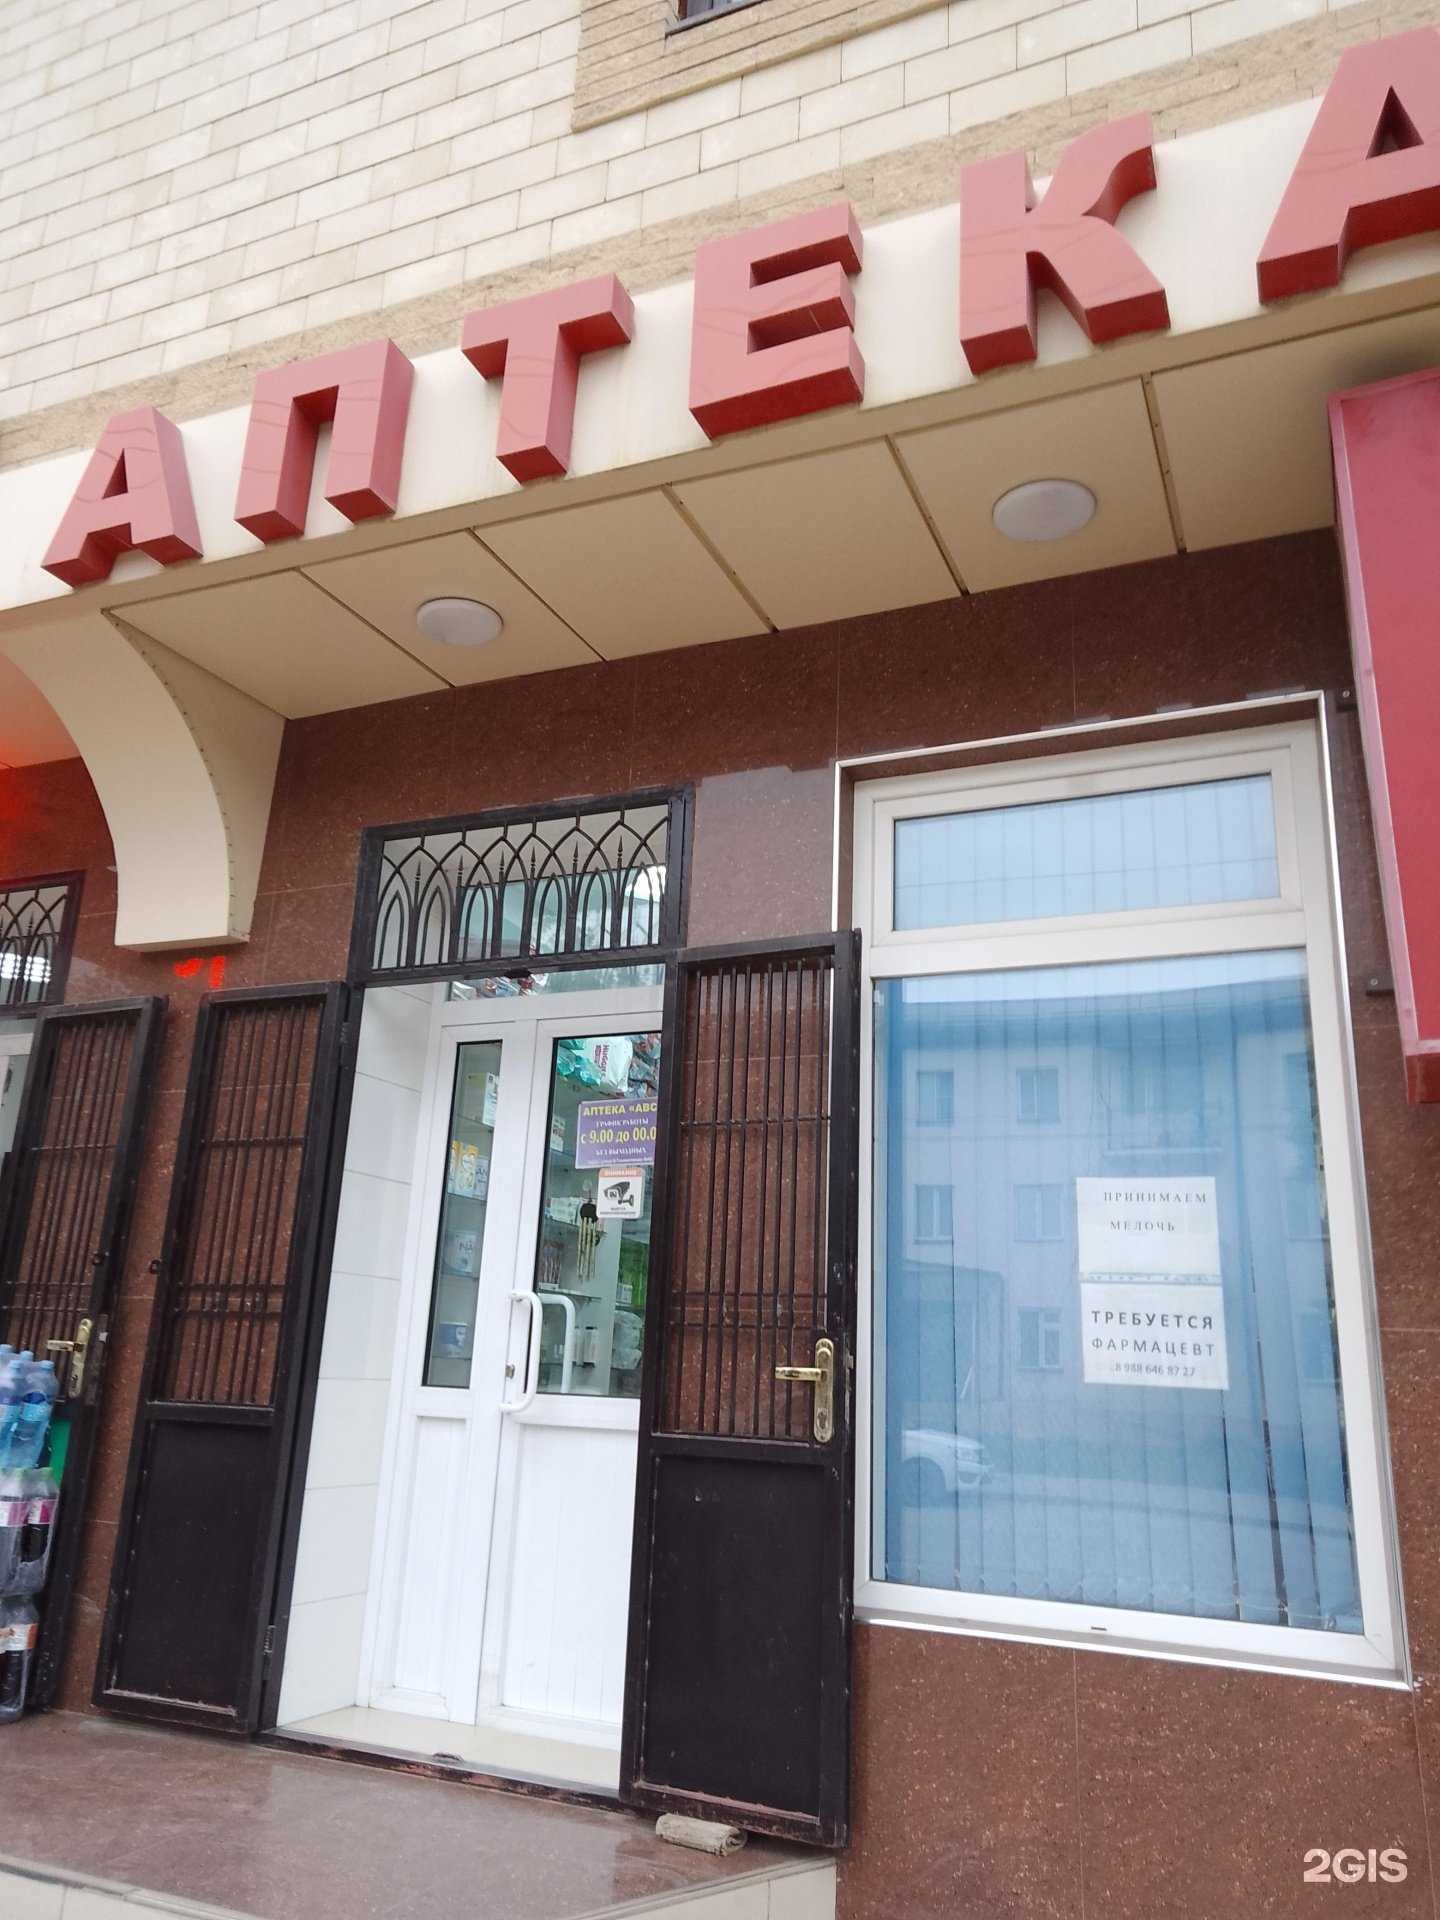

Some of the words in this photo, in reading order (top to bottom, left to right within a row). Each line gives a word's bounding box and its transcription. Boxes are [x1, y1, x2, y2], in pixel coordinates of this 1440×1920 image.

[41, 26, 1440, 588] АПТЕКА
[584, 1105, 626, 1116] АПТЕКА
[590, 1129, 613, 1143] 9.00
[633, 1126, 657, 1141] 00.0
[1104, 1191, 1207, 1203] ПРИНИМАЕМ
[1110, 1220, 1175, 1232] МЕЛОЧЬ
[1092, 1310, 1213, 1330] ТРЕБУЕТСЯ
[1092, 1337, 1215, 1358] ФАРМАЦЕВТ
